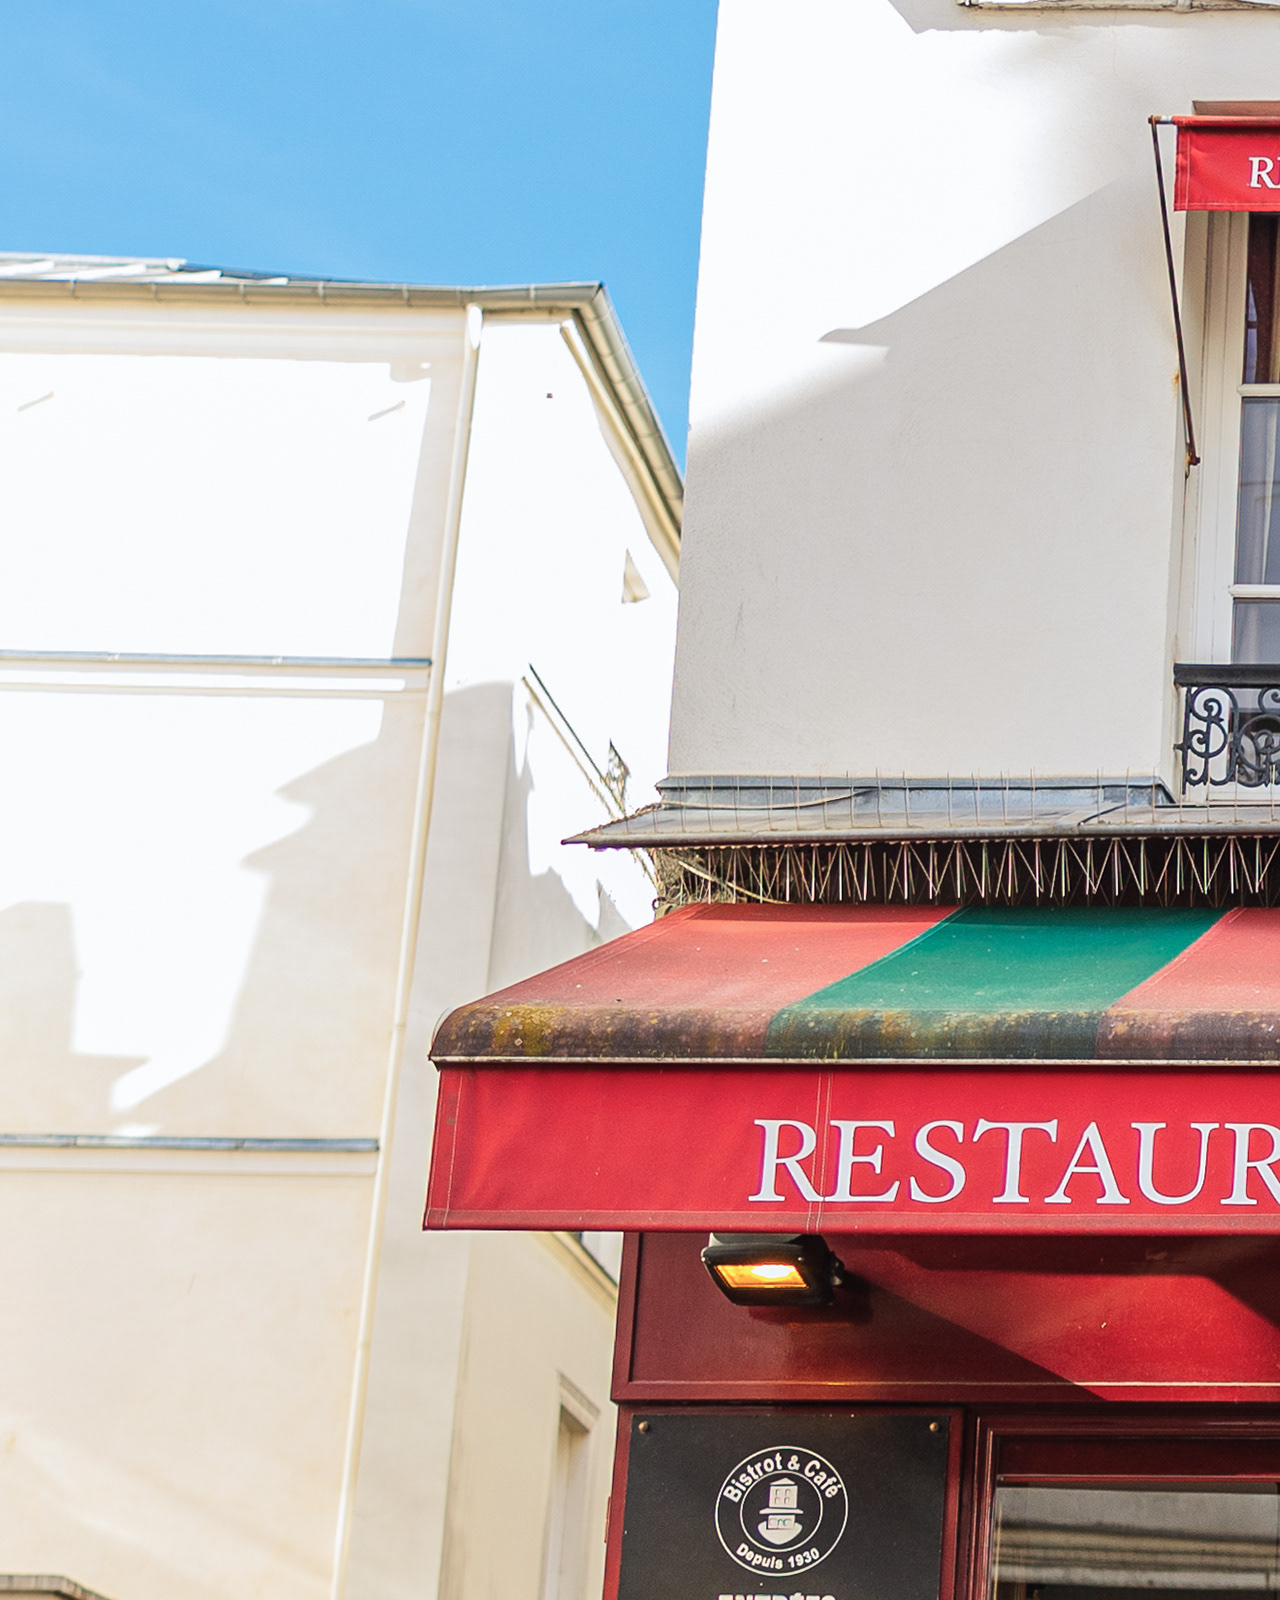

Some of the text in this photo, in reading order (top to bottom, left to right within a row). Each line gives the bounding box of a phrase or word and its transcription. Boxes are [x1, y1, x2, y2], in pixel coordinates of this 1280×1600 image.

[723, 1452, 842, 1503] Bistrot & Café
[736, 1543, 819, 1569] Depuis 1930
